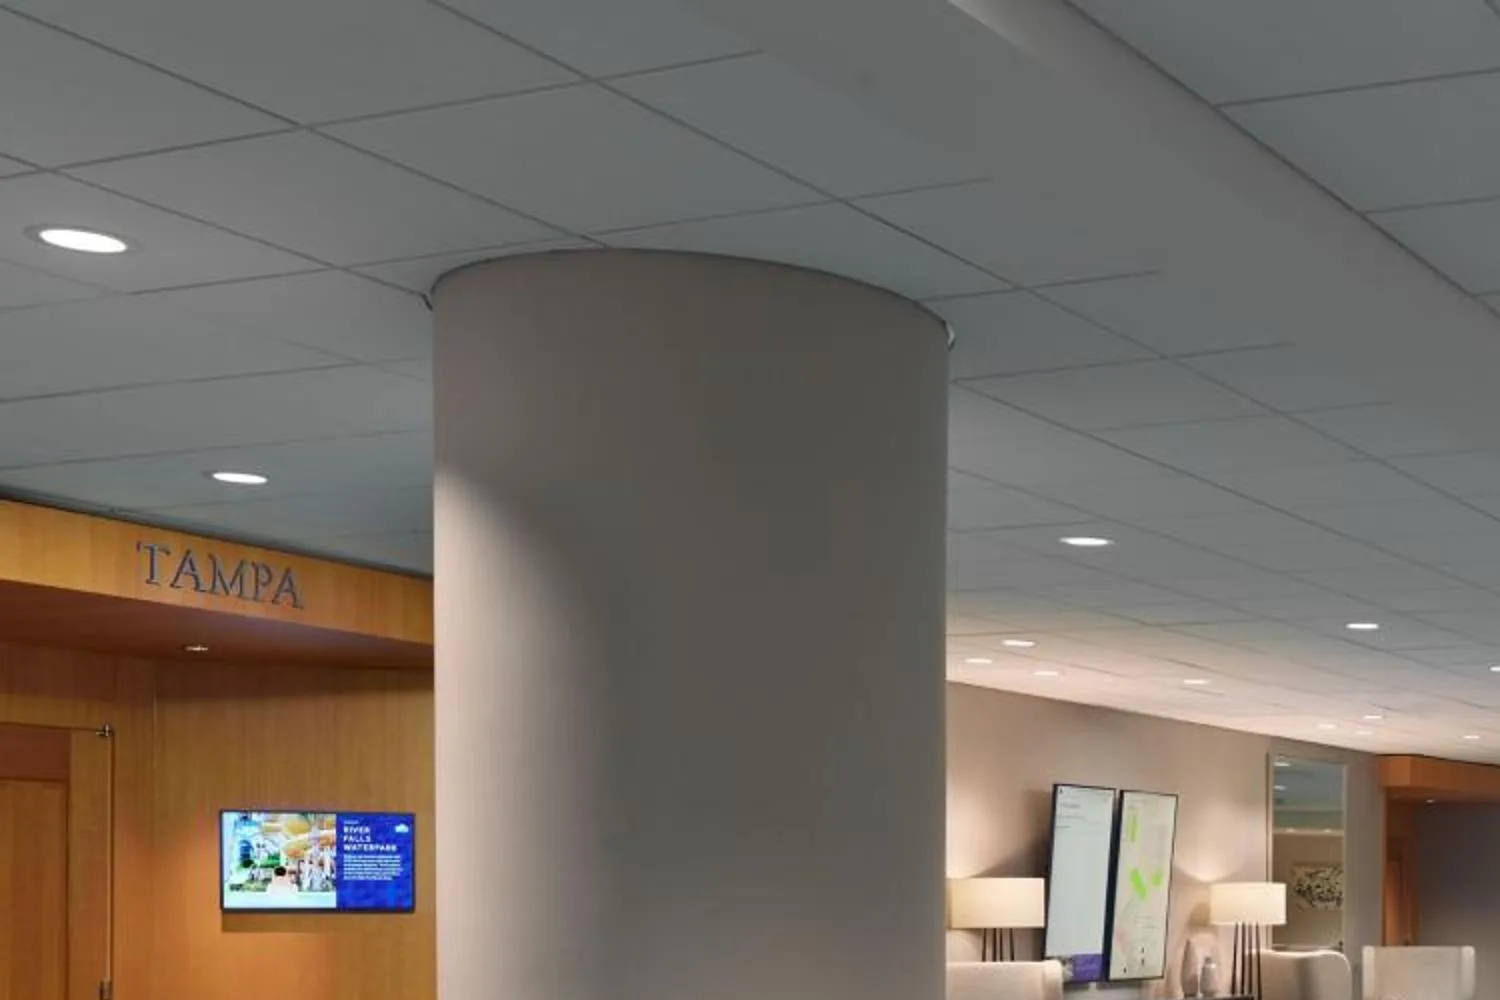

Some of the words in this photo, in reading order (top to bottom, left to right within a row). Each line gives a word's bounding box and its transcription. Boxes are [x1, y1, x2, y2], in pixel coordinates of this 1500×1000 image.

[136, 540, 304, 609] TAMPA
[343, 835, 371, 843] FALLS
[343, 844, 397, 852] WATERPARK
